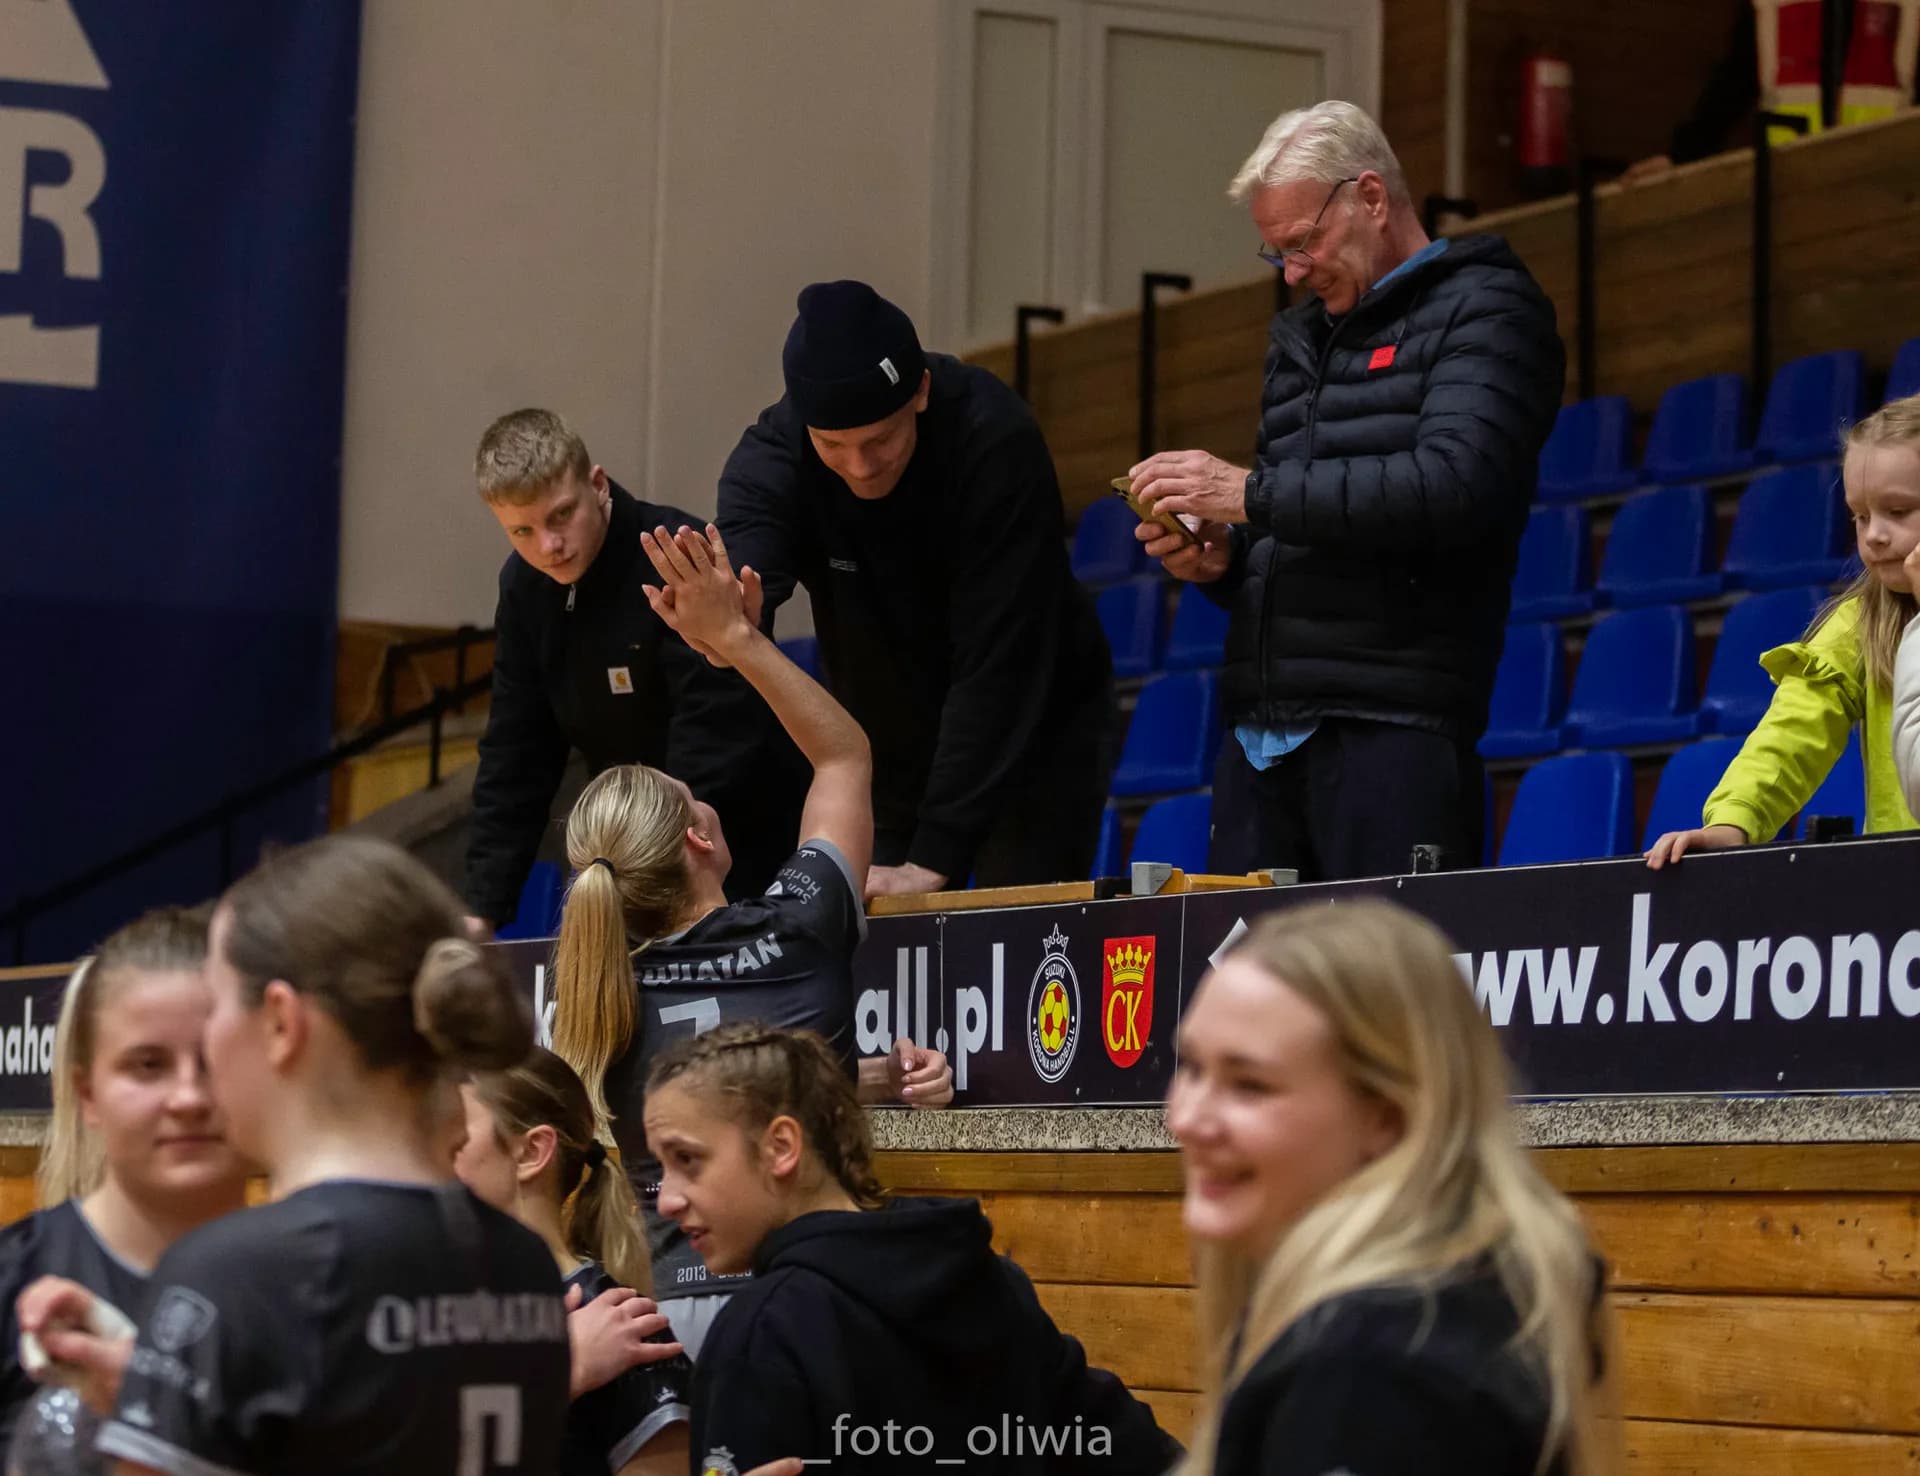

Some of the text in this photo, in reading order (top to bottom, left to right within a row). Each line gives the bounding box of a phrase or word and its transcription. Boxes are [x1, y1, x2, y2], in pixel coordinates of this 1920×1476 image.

[786, 882, 812, 905] Sun
[641, 931, 784, 986] WIATAN
[1044, 963, 1066, 981] SUZUKI
[1449, 892, 1920, 1027] ww.koron
[854, 942, 1005, 1091] all.pl
[1106, 989, 1143, 1052] CK
[1031, 1026, 1076, 1072] KORONA HANDBALL
[676, 1265, 707, 1283] 2013
